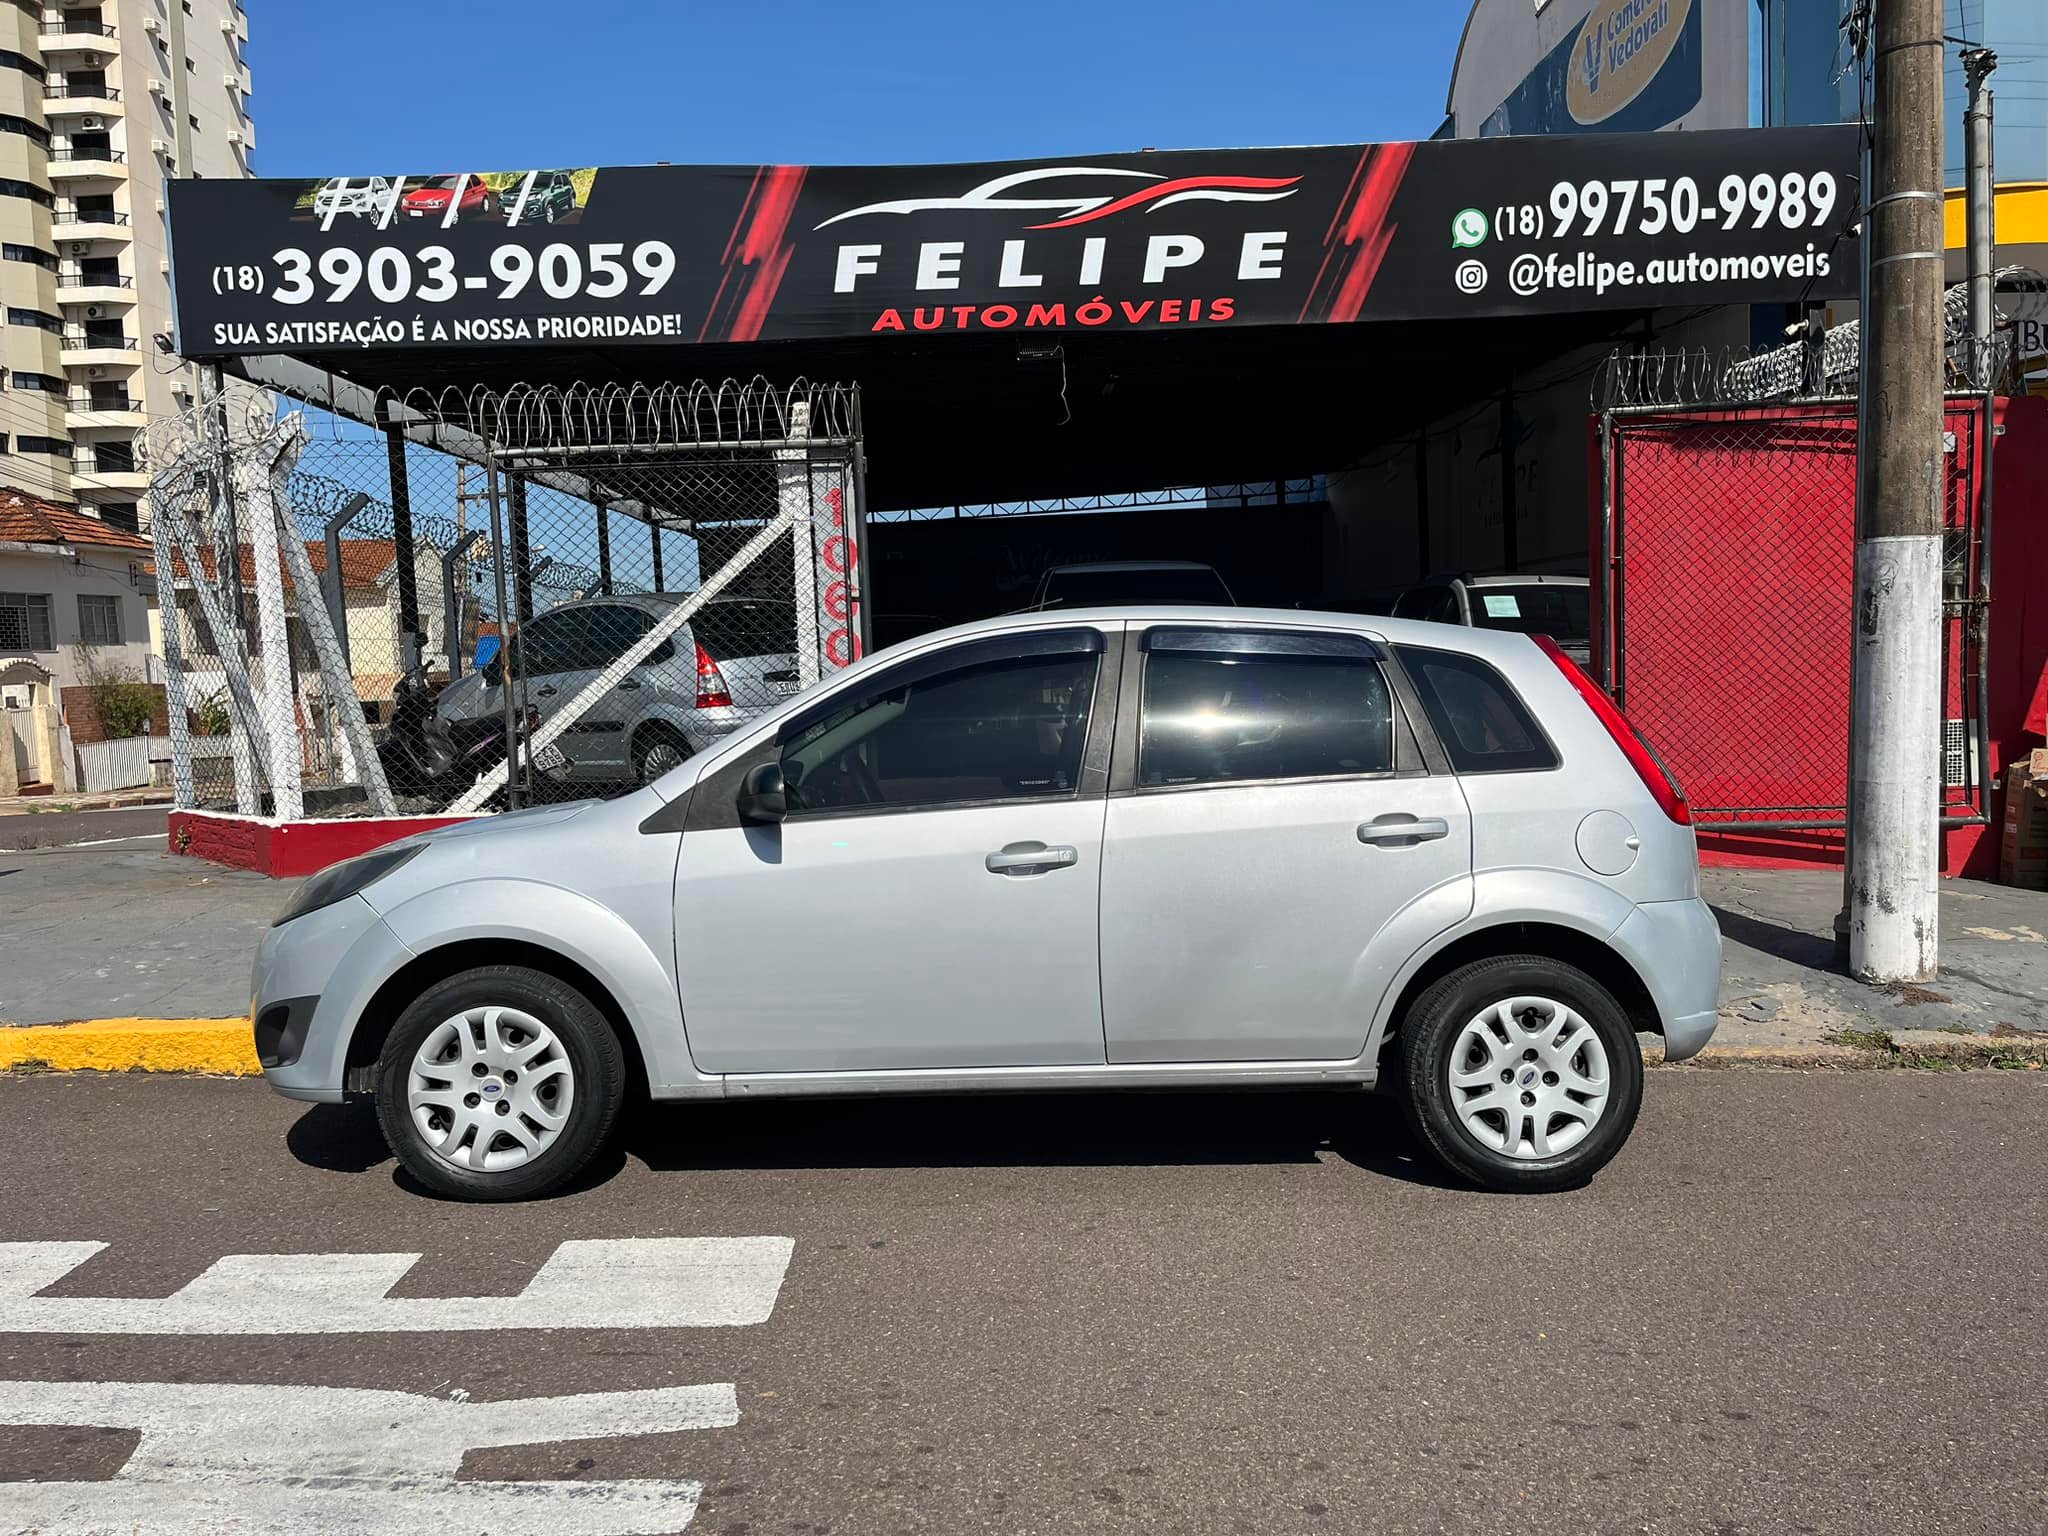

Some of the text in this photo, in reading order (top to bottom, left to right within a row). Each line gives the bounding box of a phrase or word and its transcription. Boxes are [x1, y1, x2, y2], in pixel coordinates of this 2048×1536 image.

[1608, 0, 1669, 74] Vedovati
[1494, 170, 1838, 240] (18) 99750-9989
[212, 240, 676, 305] (18) 3903-9059
[834, 231, 1288, 293] FELIPE
[1508, 243, 1831, 296] @felipe.automoveis
[213, 313, 683, 349] SUA SATISFAÇÃO É A NOSSA PRIORIDADE!
[871, 295, 1237, 333] AUTOMÓVEIS
